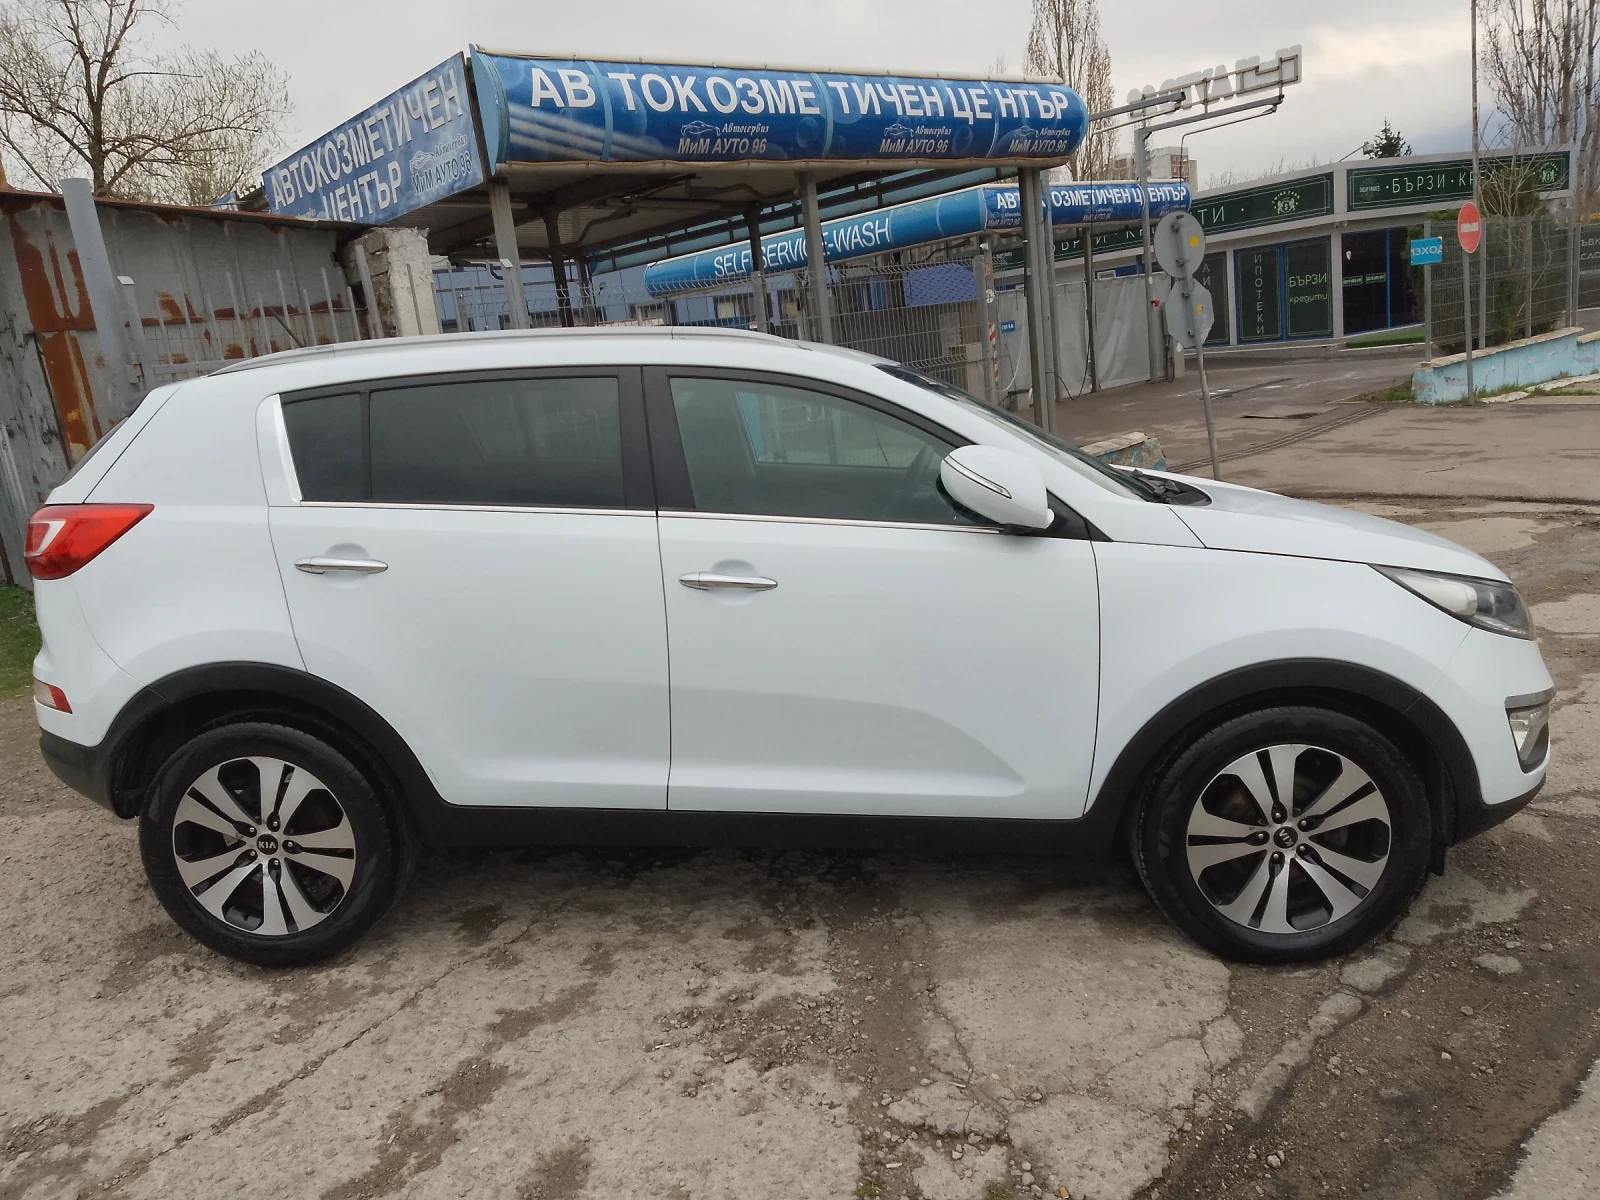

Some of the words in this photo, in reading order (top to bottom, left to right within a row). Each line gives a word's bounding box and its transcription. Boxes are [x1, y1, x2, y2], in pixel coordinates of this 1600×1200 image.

[722, 122, 770, 136] Автосервиз
[270, 68, 463, 211] АВТОКОЗМЕТИЧЕН
[677, 137, 711, 154] МиМ
[712, 138, 750, 154] АУТО
[751, 138, 768, 153] 96
[879, 138, 906, 153] МиМ
[906, 139, 937, 153] АУТО
[936, 139, 949, 153] 96
[1008, 139, 1031, 153] МиМ
[1030, 140, 1056, 152] АУТО
[1055, 140, 1068, 151] 96
[435, 156, 459, 188] АУТО
[459, 150, 473, 176] 96
[322, 160, 402, 222] ЦЕНТЪР
[1392, 172, 1446, 193] БЪРЗИ
[713, 251, 753, 278] SELF
[1289, 272, 1328, 288] БЪРЗИ
[1254, 253, 1265, 335] ИПОТЕКИ
[1289, 293, 1328, 305] кредити
[258, 841, 277, 849] KIA
[1278, 828, 1294, 847] KIA
